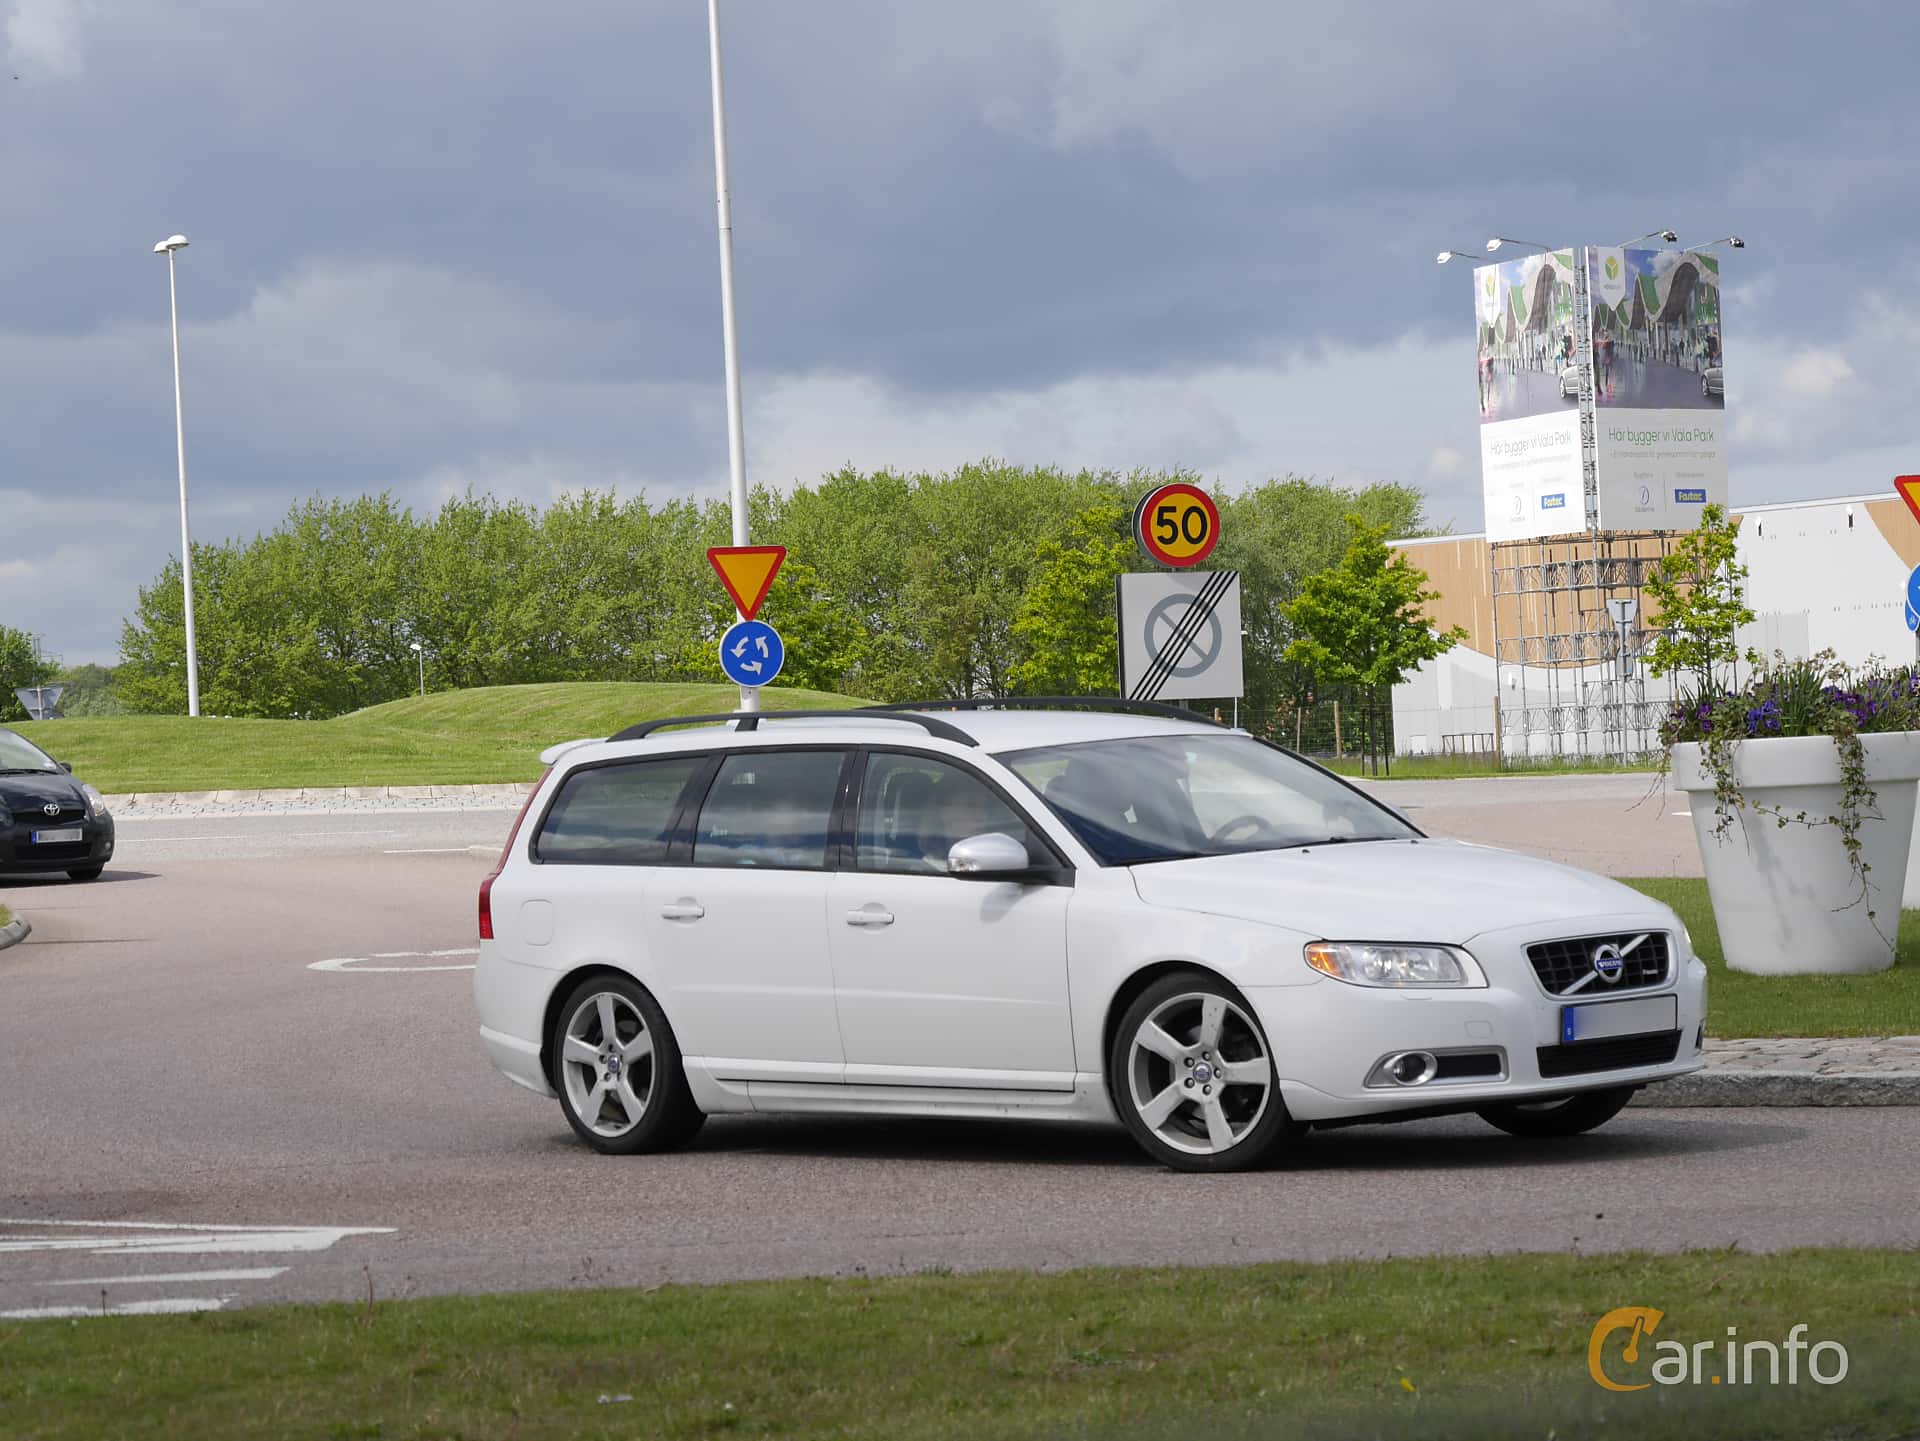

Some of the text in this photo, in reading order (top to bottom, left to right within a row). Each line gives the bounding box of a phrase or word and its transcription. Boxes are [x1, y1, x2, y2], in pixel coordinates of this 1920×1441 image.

[1627, 427, 1660, 446] bygger
[1694, 428, 1714, 442] Park
[1156, 505, 1208, 545] 50
